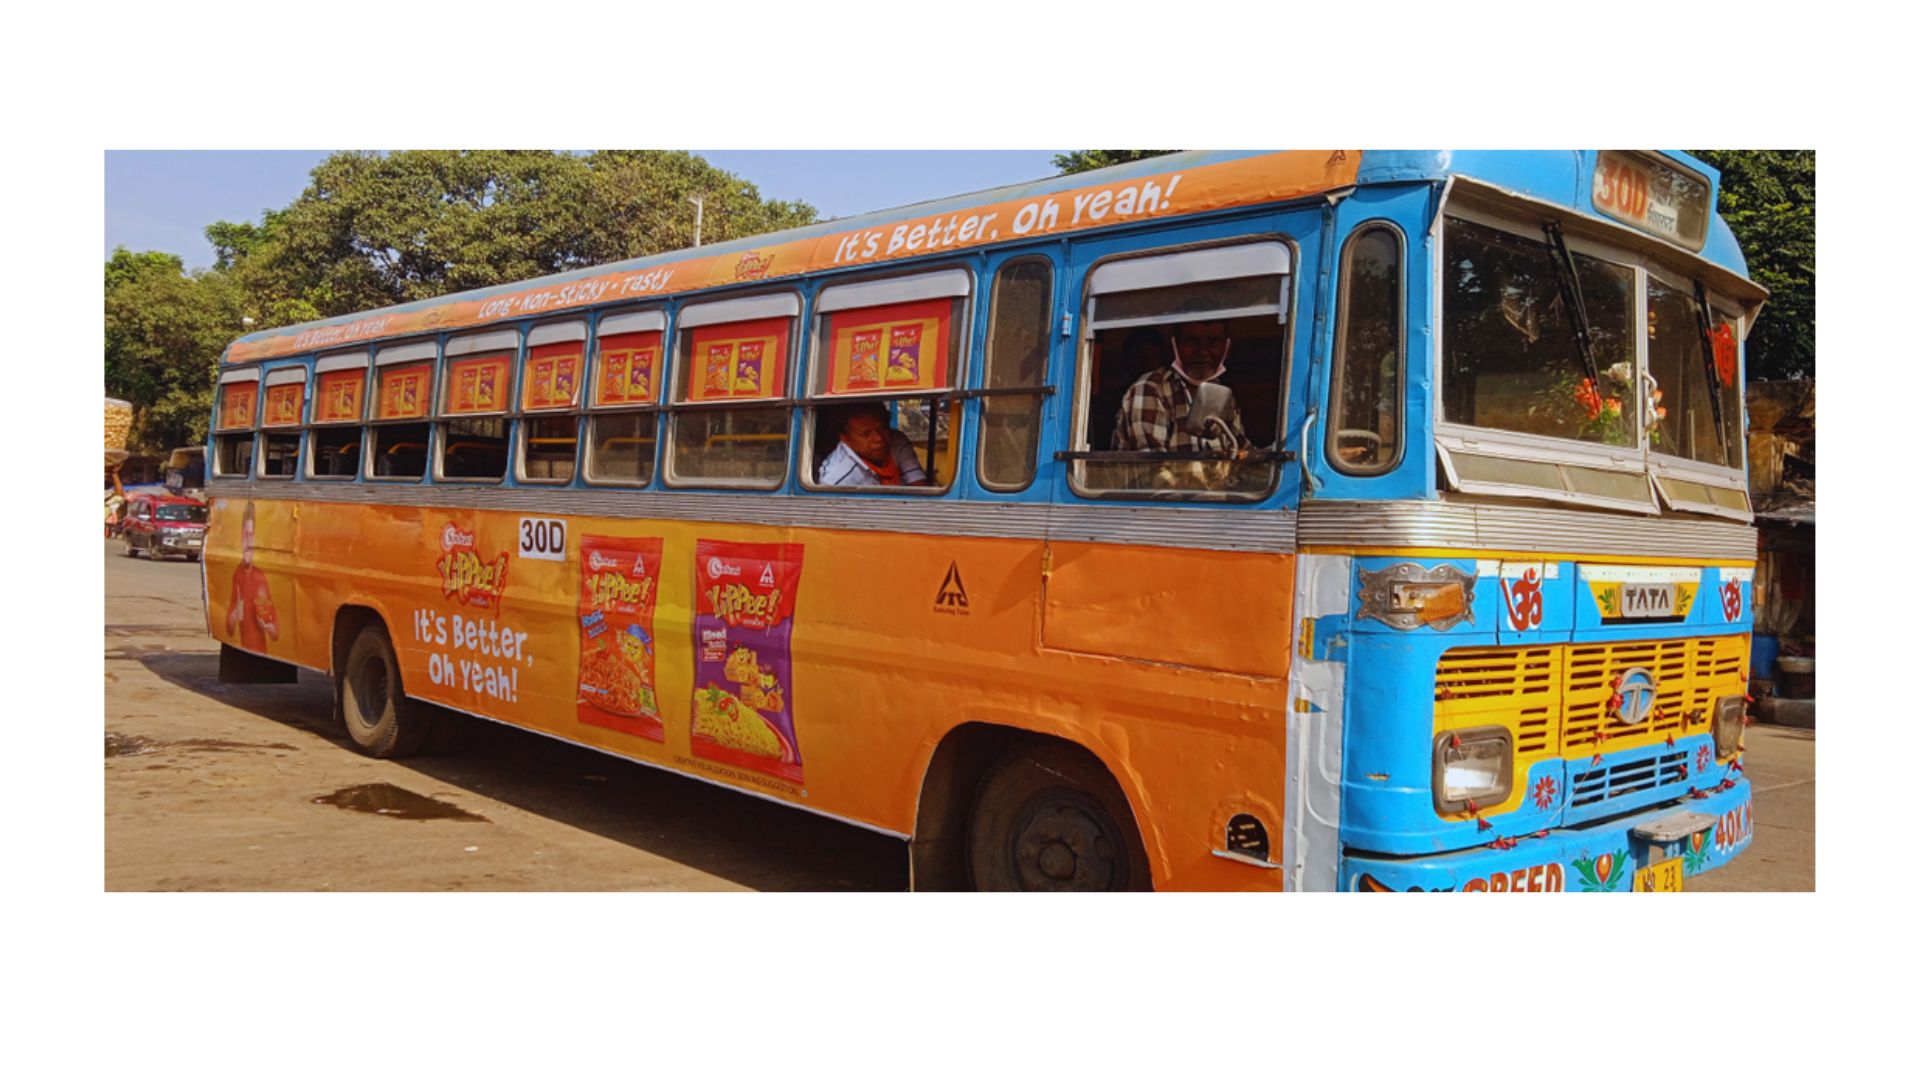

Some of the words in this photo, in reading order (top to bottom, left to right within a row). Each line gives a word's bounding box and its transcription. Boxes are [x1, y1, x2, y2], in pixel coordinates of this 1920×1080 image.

[834, 231, 882, 264] It's
[886, 210, 999, 256] Better,
[1012, 199, 1060, 235] Oh
[1072, 174, 1182, 226] Yeah!
[522, 520, 564, 553] 30D
[1625, 587, 1670, 611] TATA
[414, 608, 448, 645] It's
[452, 614, 534, 667] Better,
[429, 653, 456, 688] Oh
[460, 658, 519, 703] Yeah!
